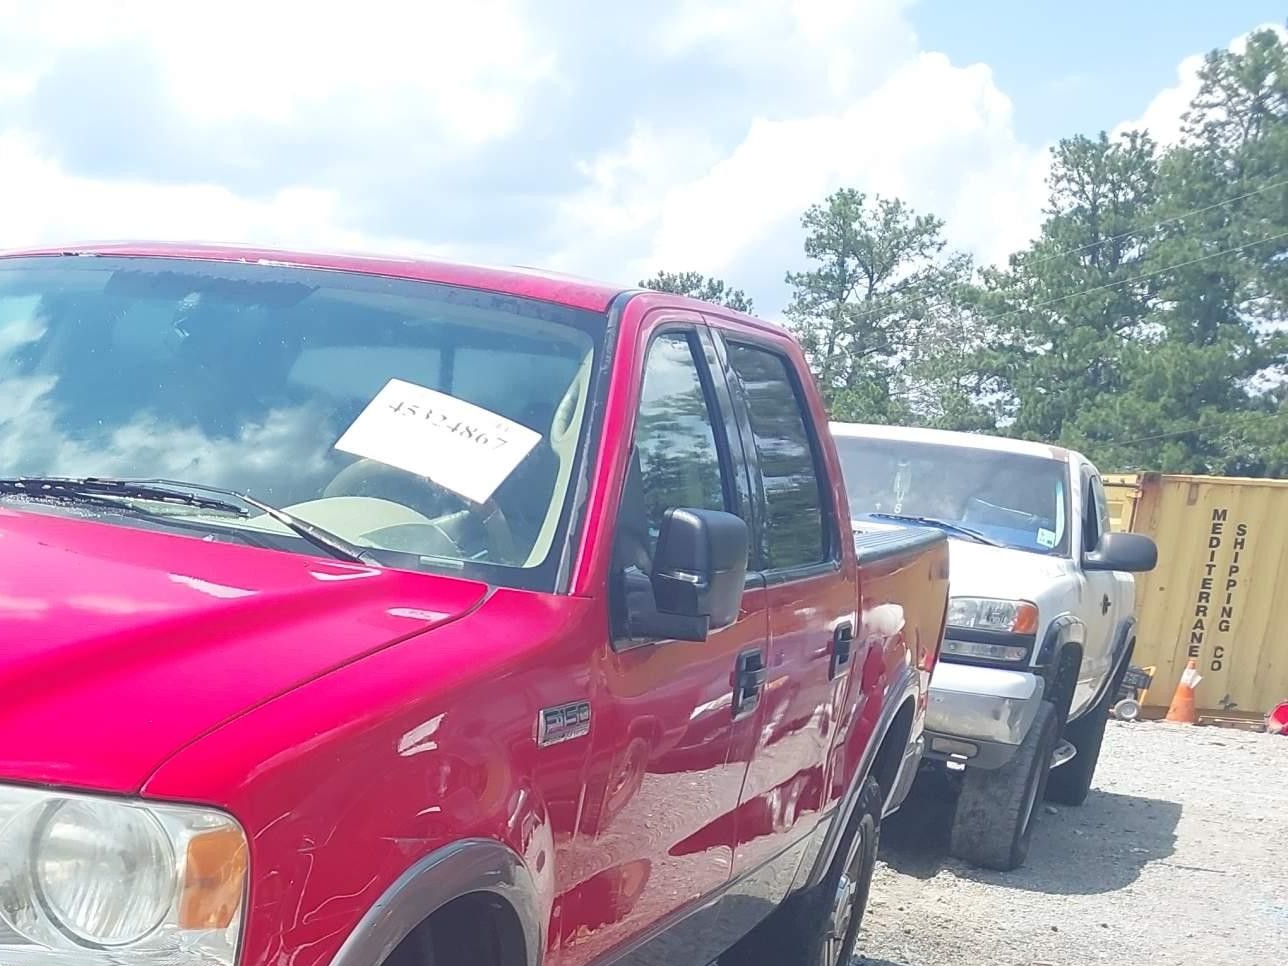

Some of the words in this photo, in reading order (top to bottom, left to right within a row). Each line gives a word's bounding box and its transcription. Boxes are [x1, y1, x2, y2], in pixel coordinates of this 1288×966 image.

[388, 401, 508, 450] 45324867
[1218, 524, 1247, 632] SHIPPING
[1211, 646, 1224, 672] CO
